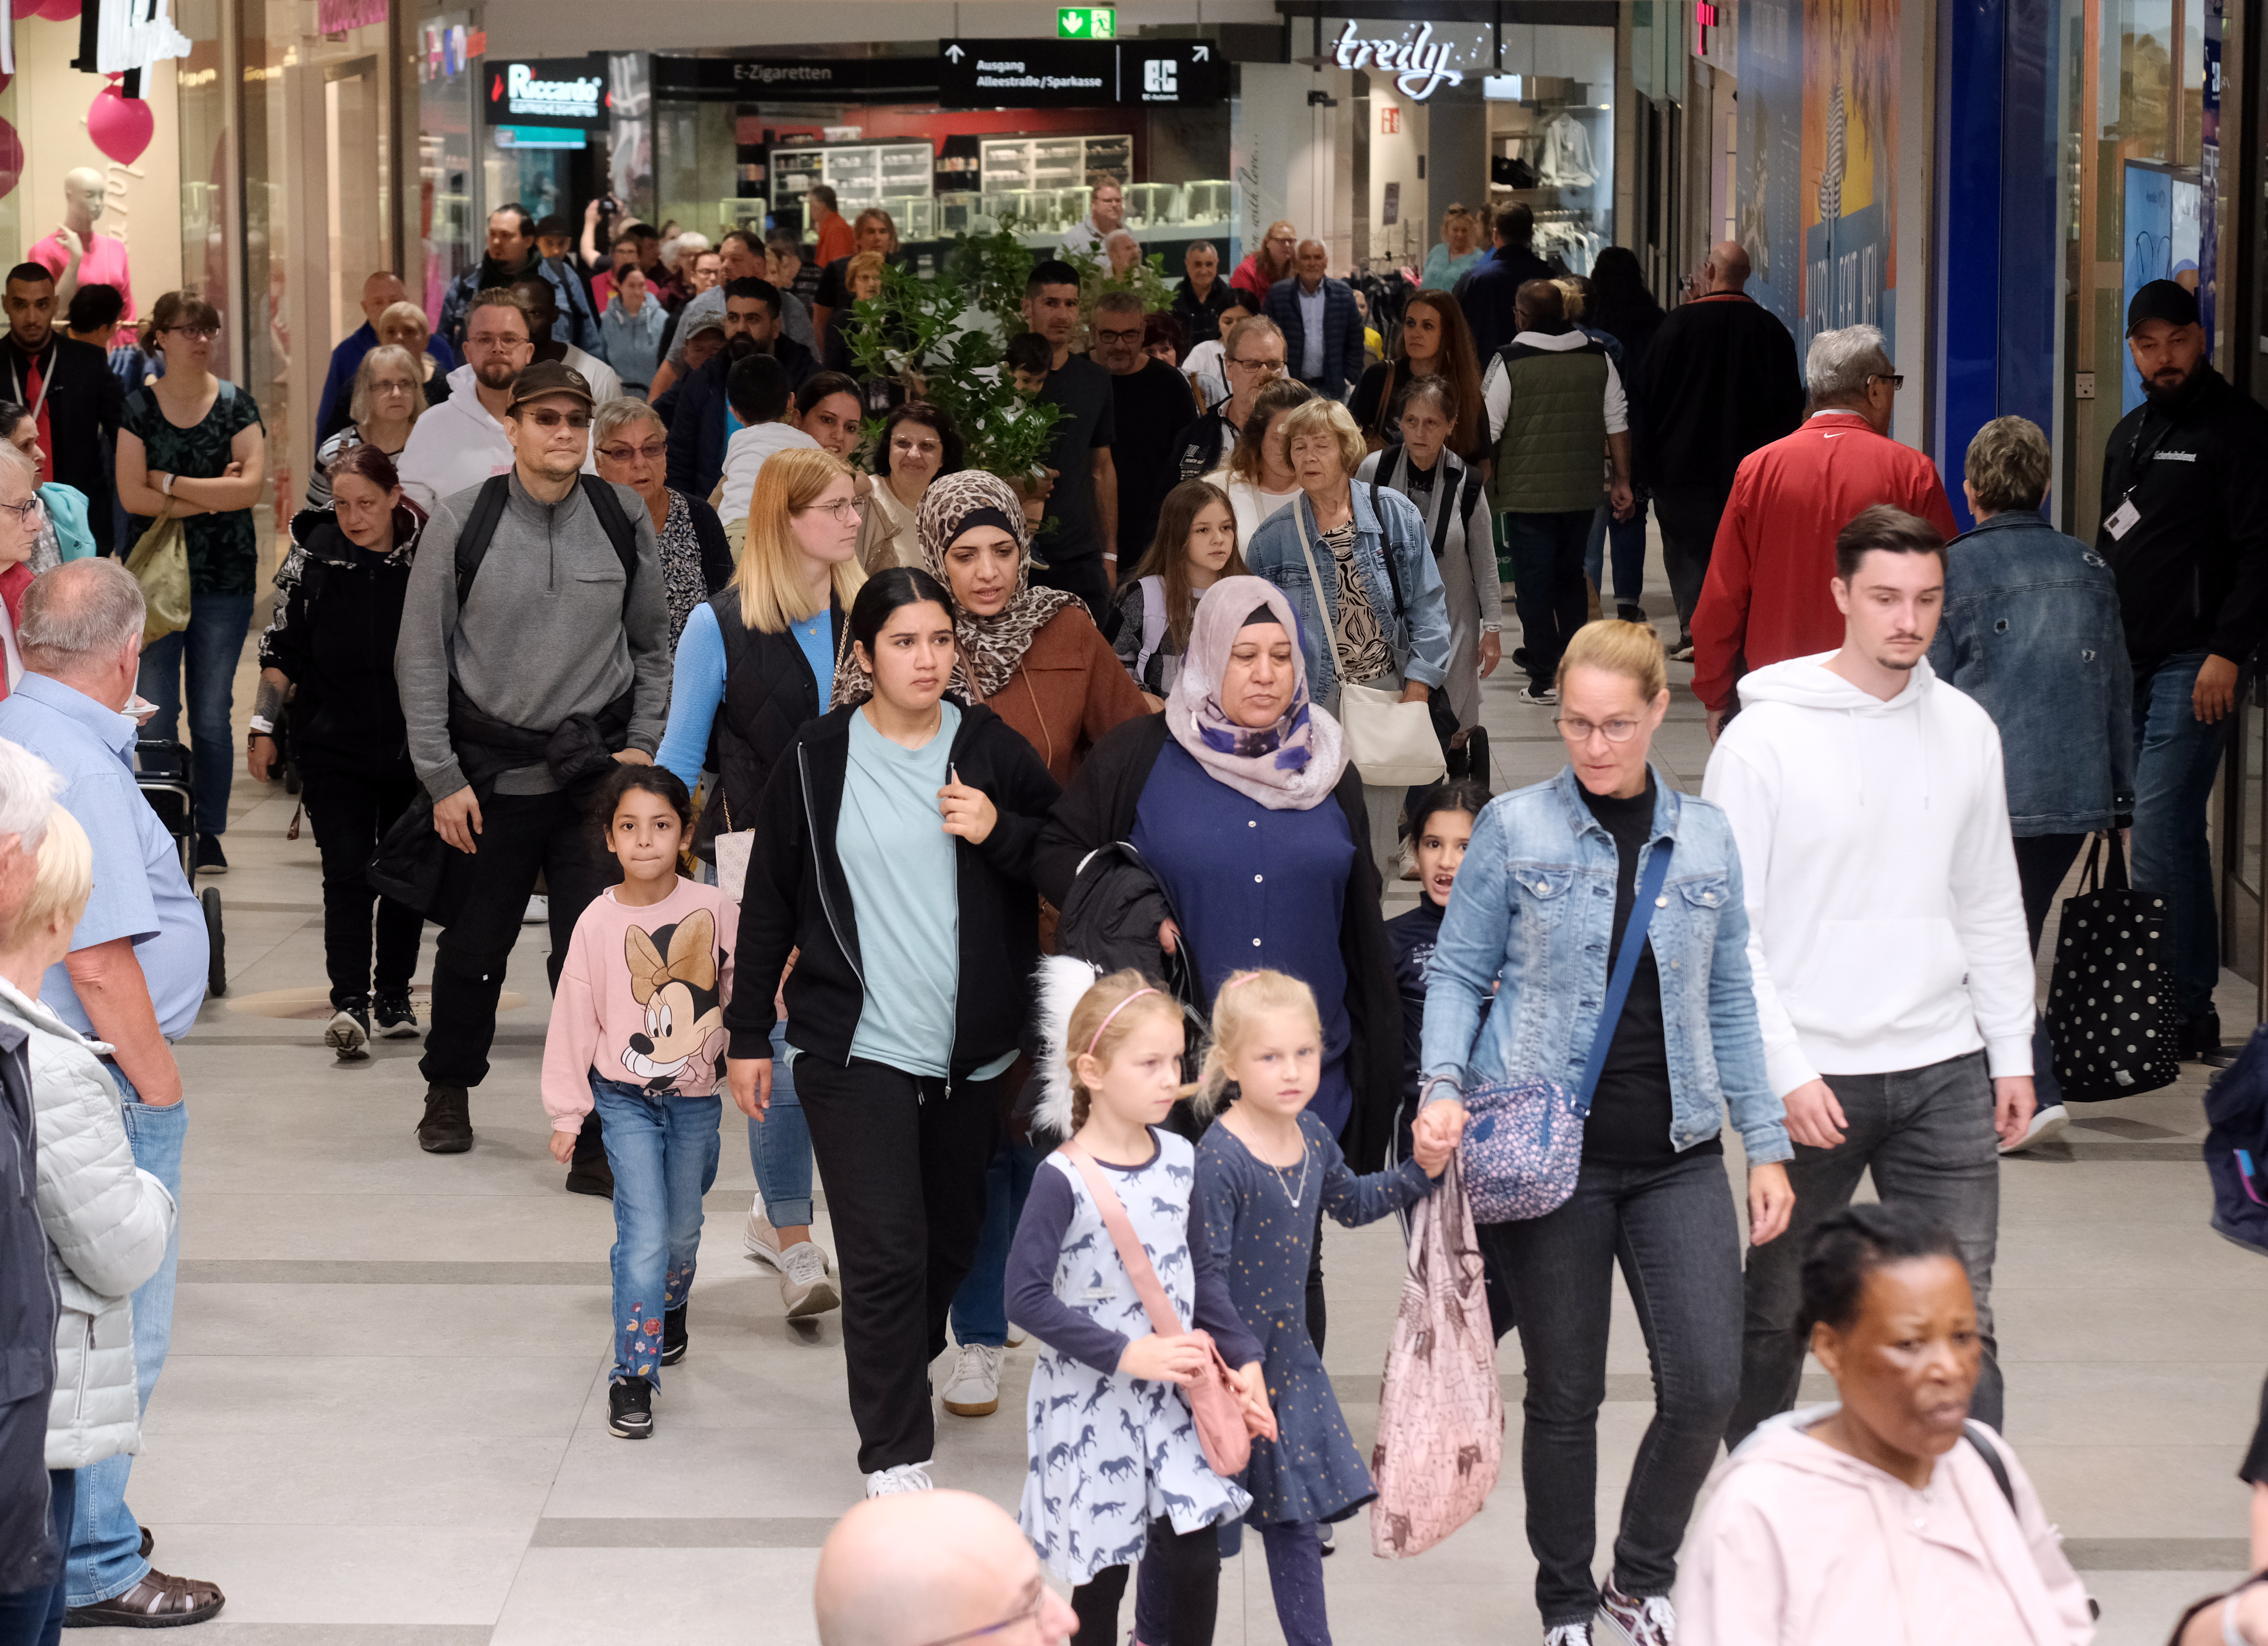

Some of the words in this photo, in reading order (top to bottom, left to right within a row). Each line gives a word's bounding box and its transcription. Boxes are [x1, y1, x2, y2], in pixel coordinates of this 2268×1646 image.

[976, 60, 1025, 73] Ausgang
[733, 64, 833, 84] E-Zigaretten
[976, 75, 1103, 89] Alleestraße/Sparkasse
